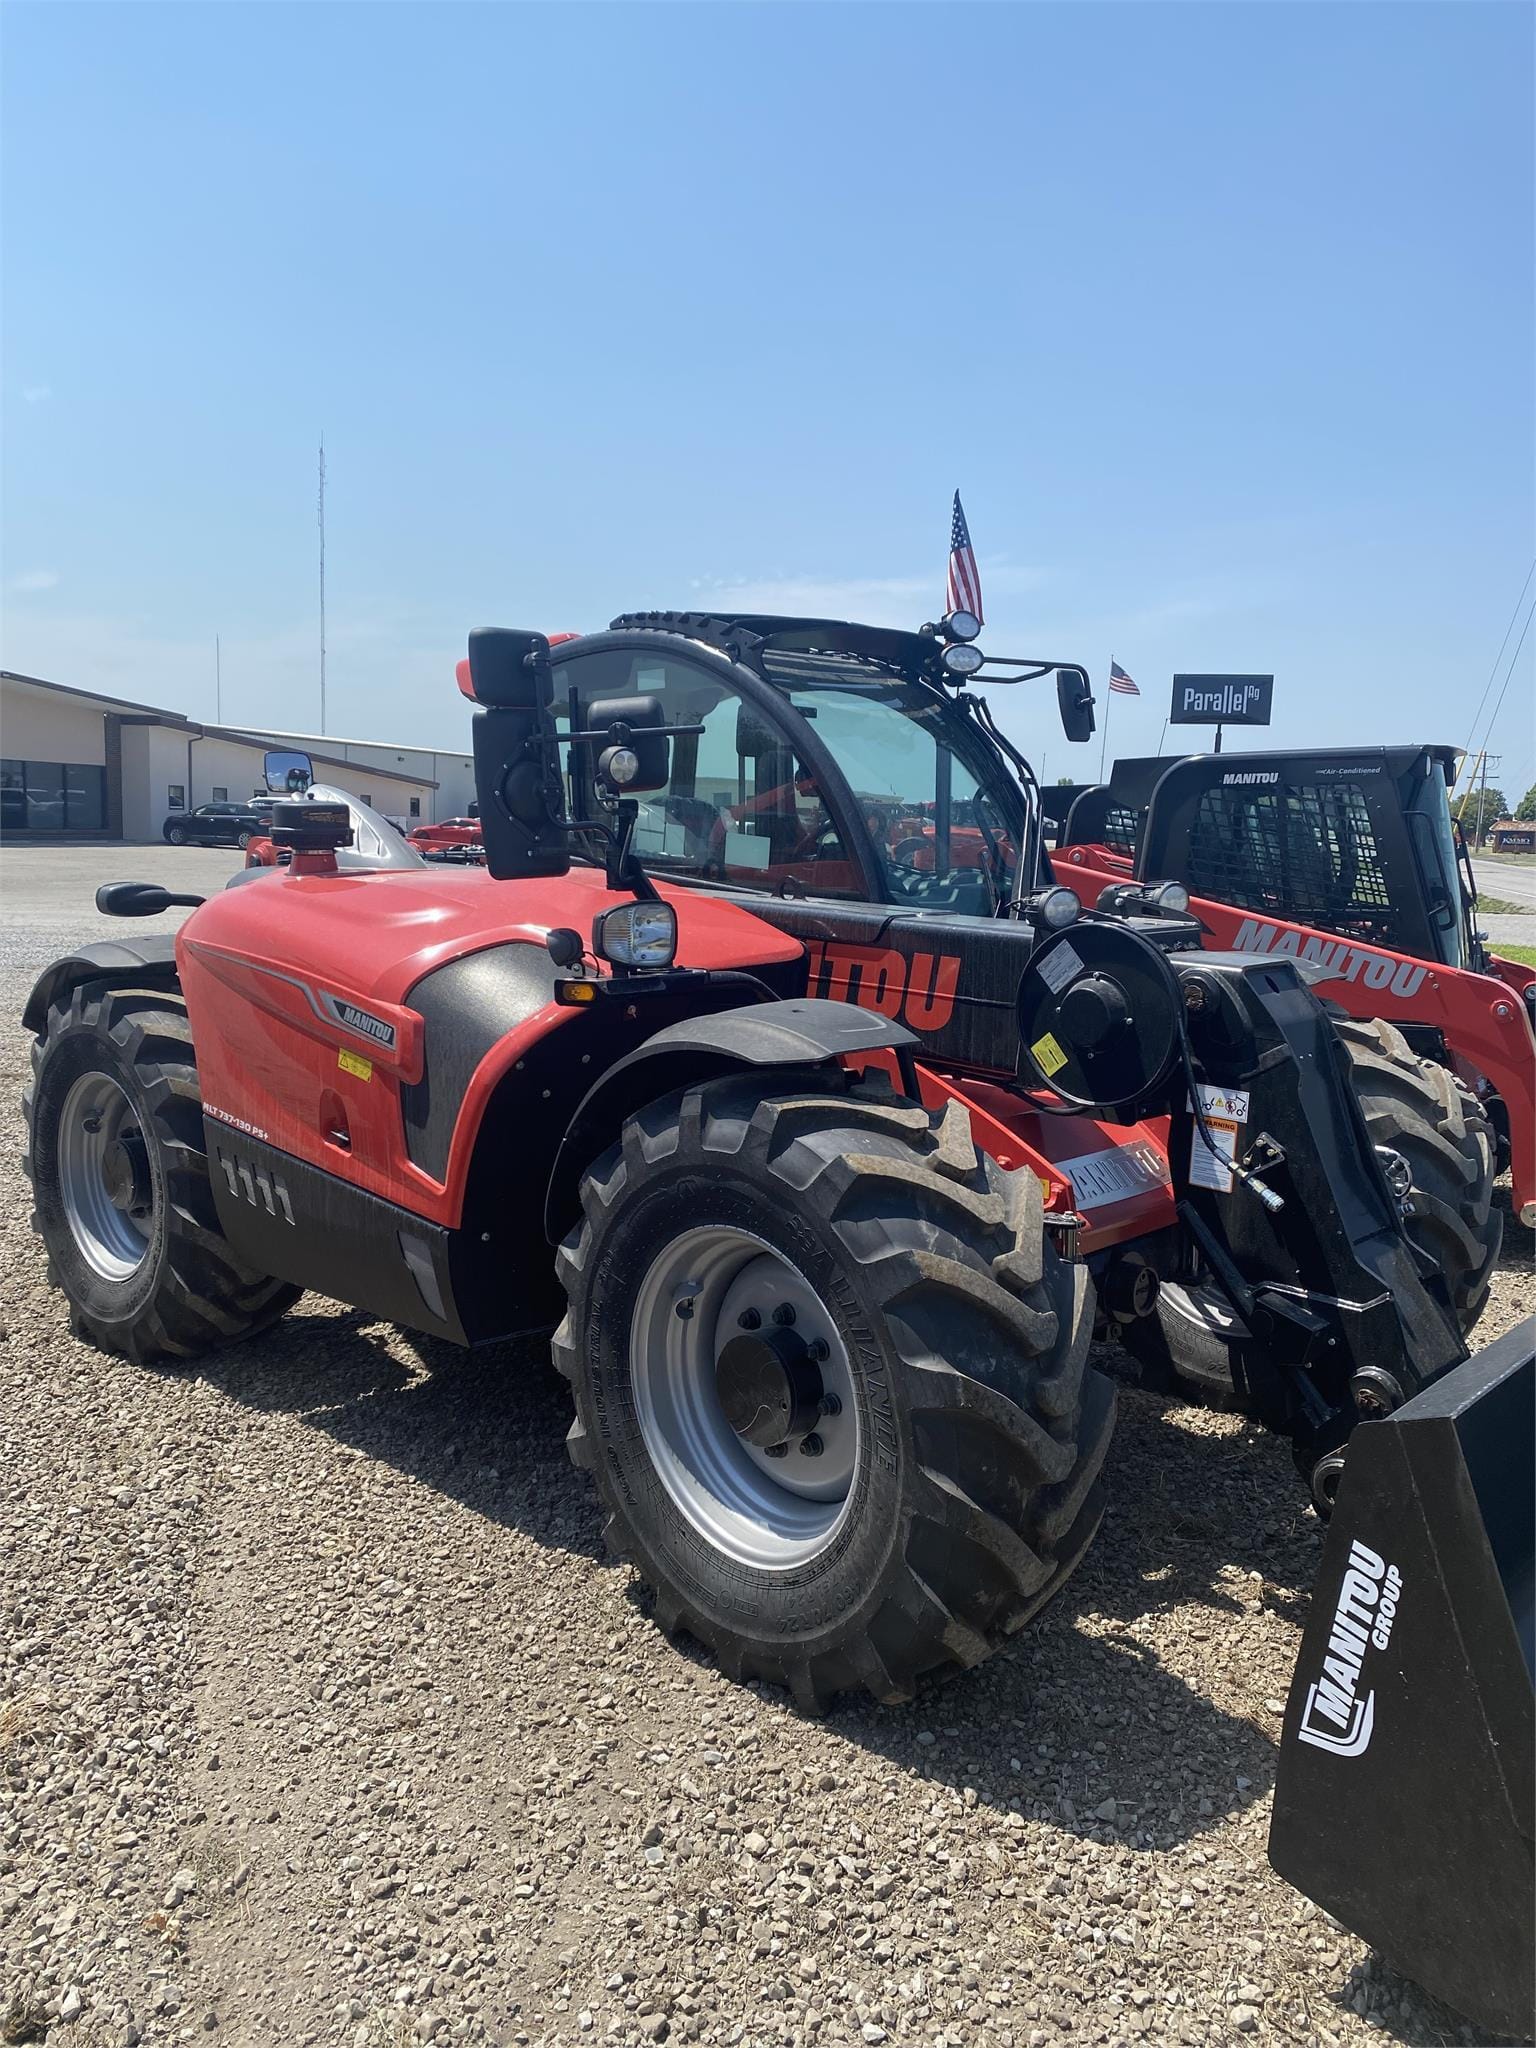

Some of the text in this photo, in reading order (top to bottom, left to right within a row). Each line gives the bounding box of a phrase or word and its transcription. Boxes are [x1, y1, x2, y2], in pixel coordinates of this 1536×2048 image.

[1183, 685, 1260, 714] Parallel Ag
[1222, 772, 1279, 785] MANITOU
[1324, 767, 1382, 775] Air-Conditioned
[1232, 918, 1428, 998] MANITOU
[806, 939, 961, 1031] ITOU
[343, 1006, 392, 1041] MANITOU
[202, 1101, 269, 1140] MLT 737-130 PS+
[1069, 1147, 1164, 1202] ANITOU
[1371, 1564, 1404, 1651] GROUP
[1314, 1539, 1386, 1730] MANITOU
